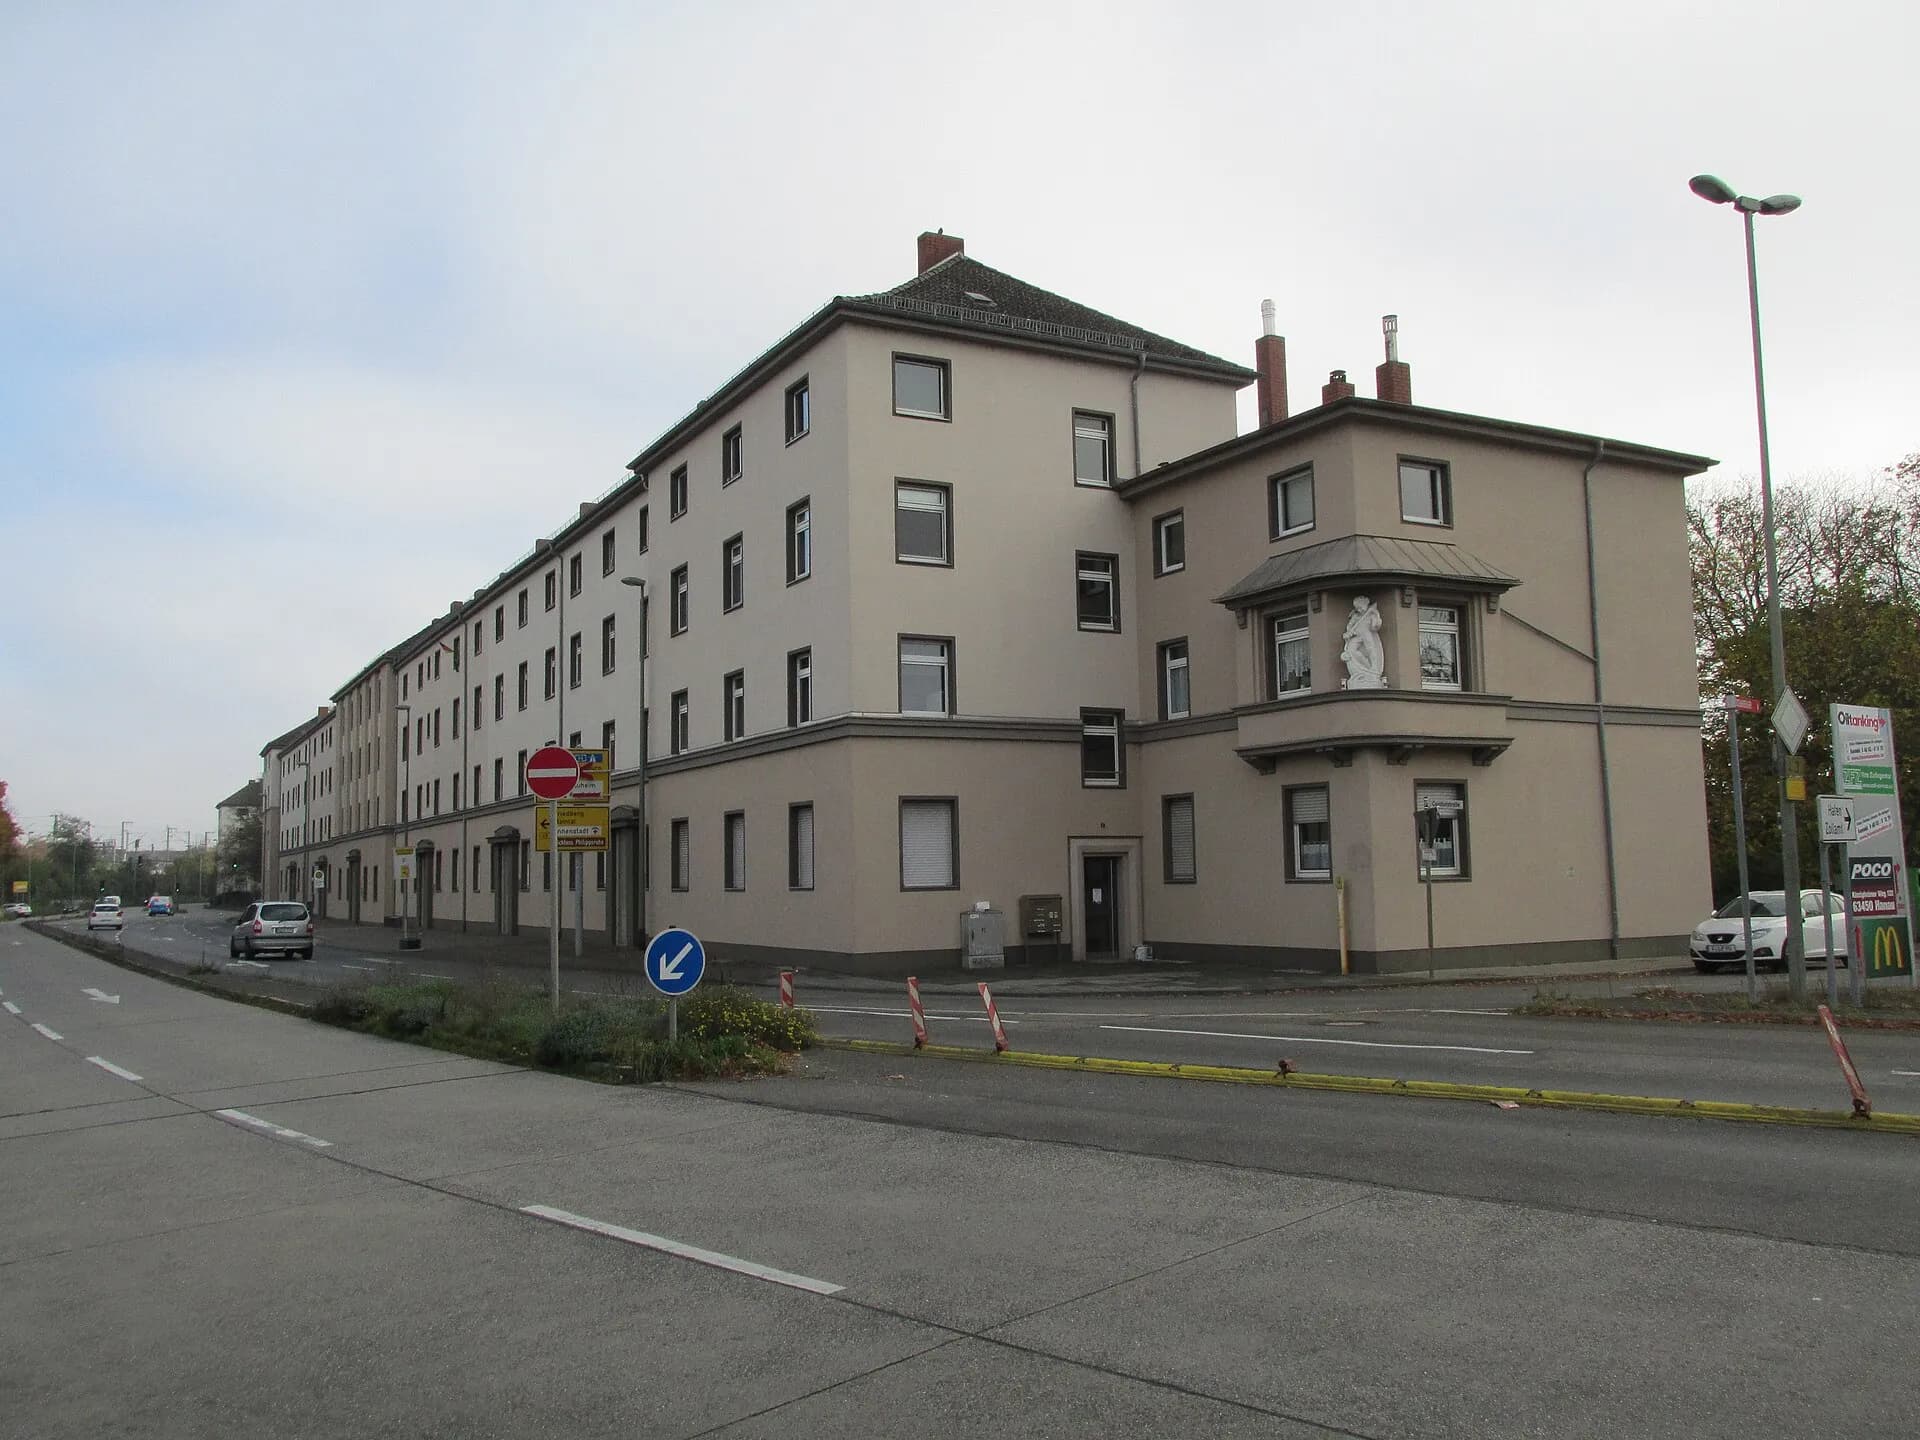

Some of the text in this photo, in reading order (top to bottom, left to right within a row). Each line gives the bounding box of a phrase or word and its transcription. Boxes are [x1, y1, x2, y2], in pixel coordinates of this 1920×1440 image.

[1838, 711, 1879, 732] Oiltanking
[1851, 863, 1892, 879] POCO
[1852, 900, 1874, 912] 63450
